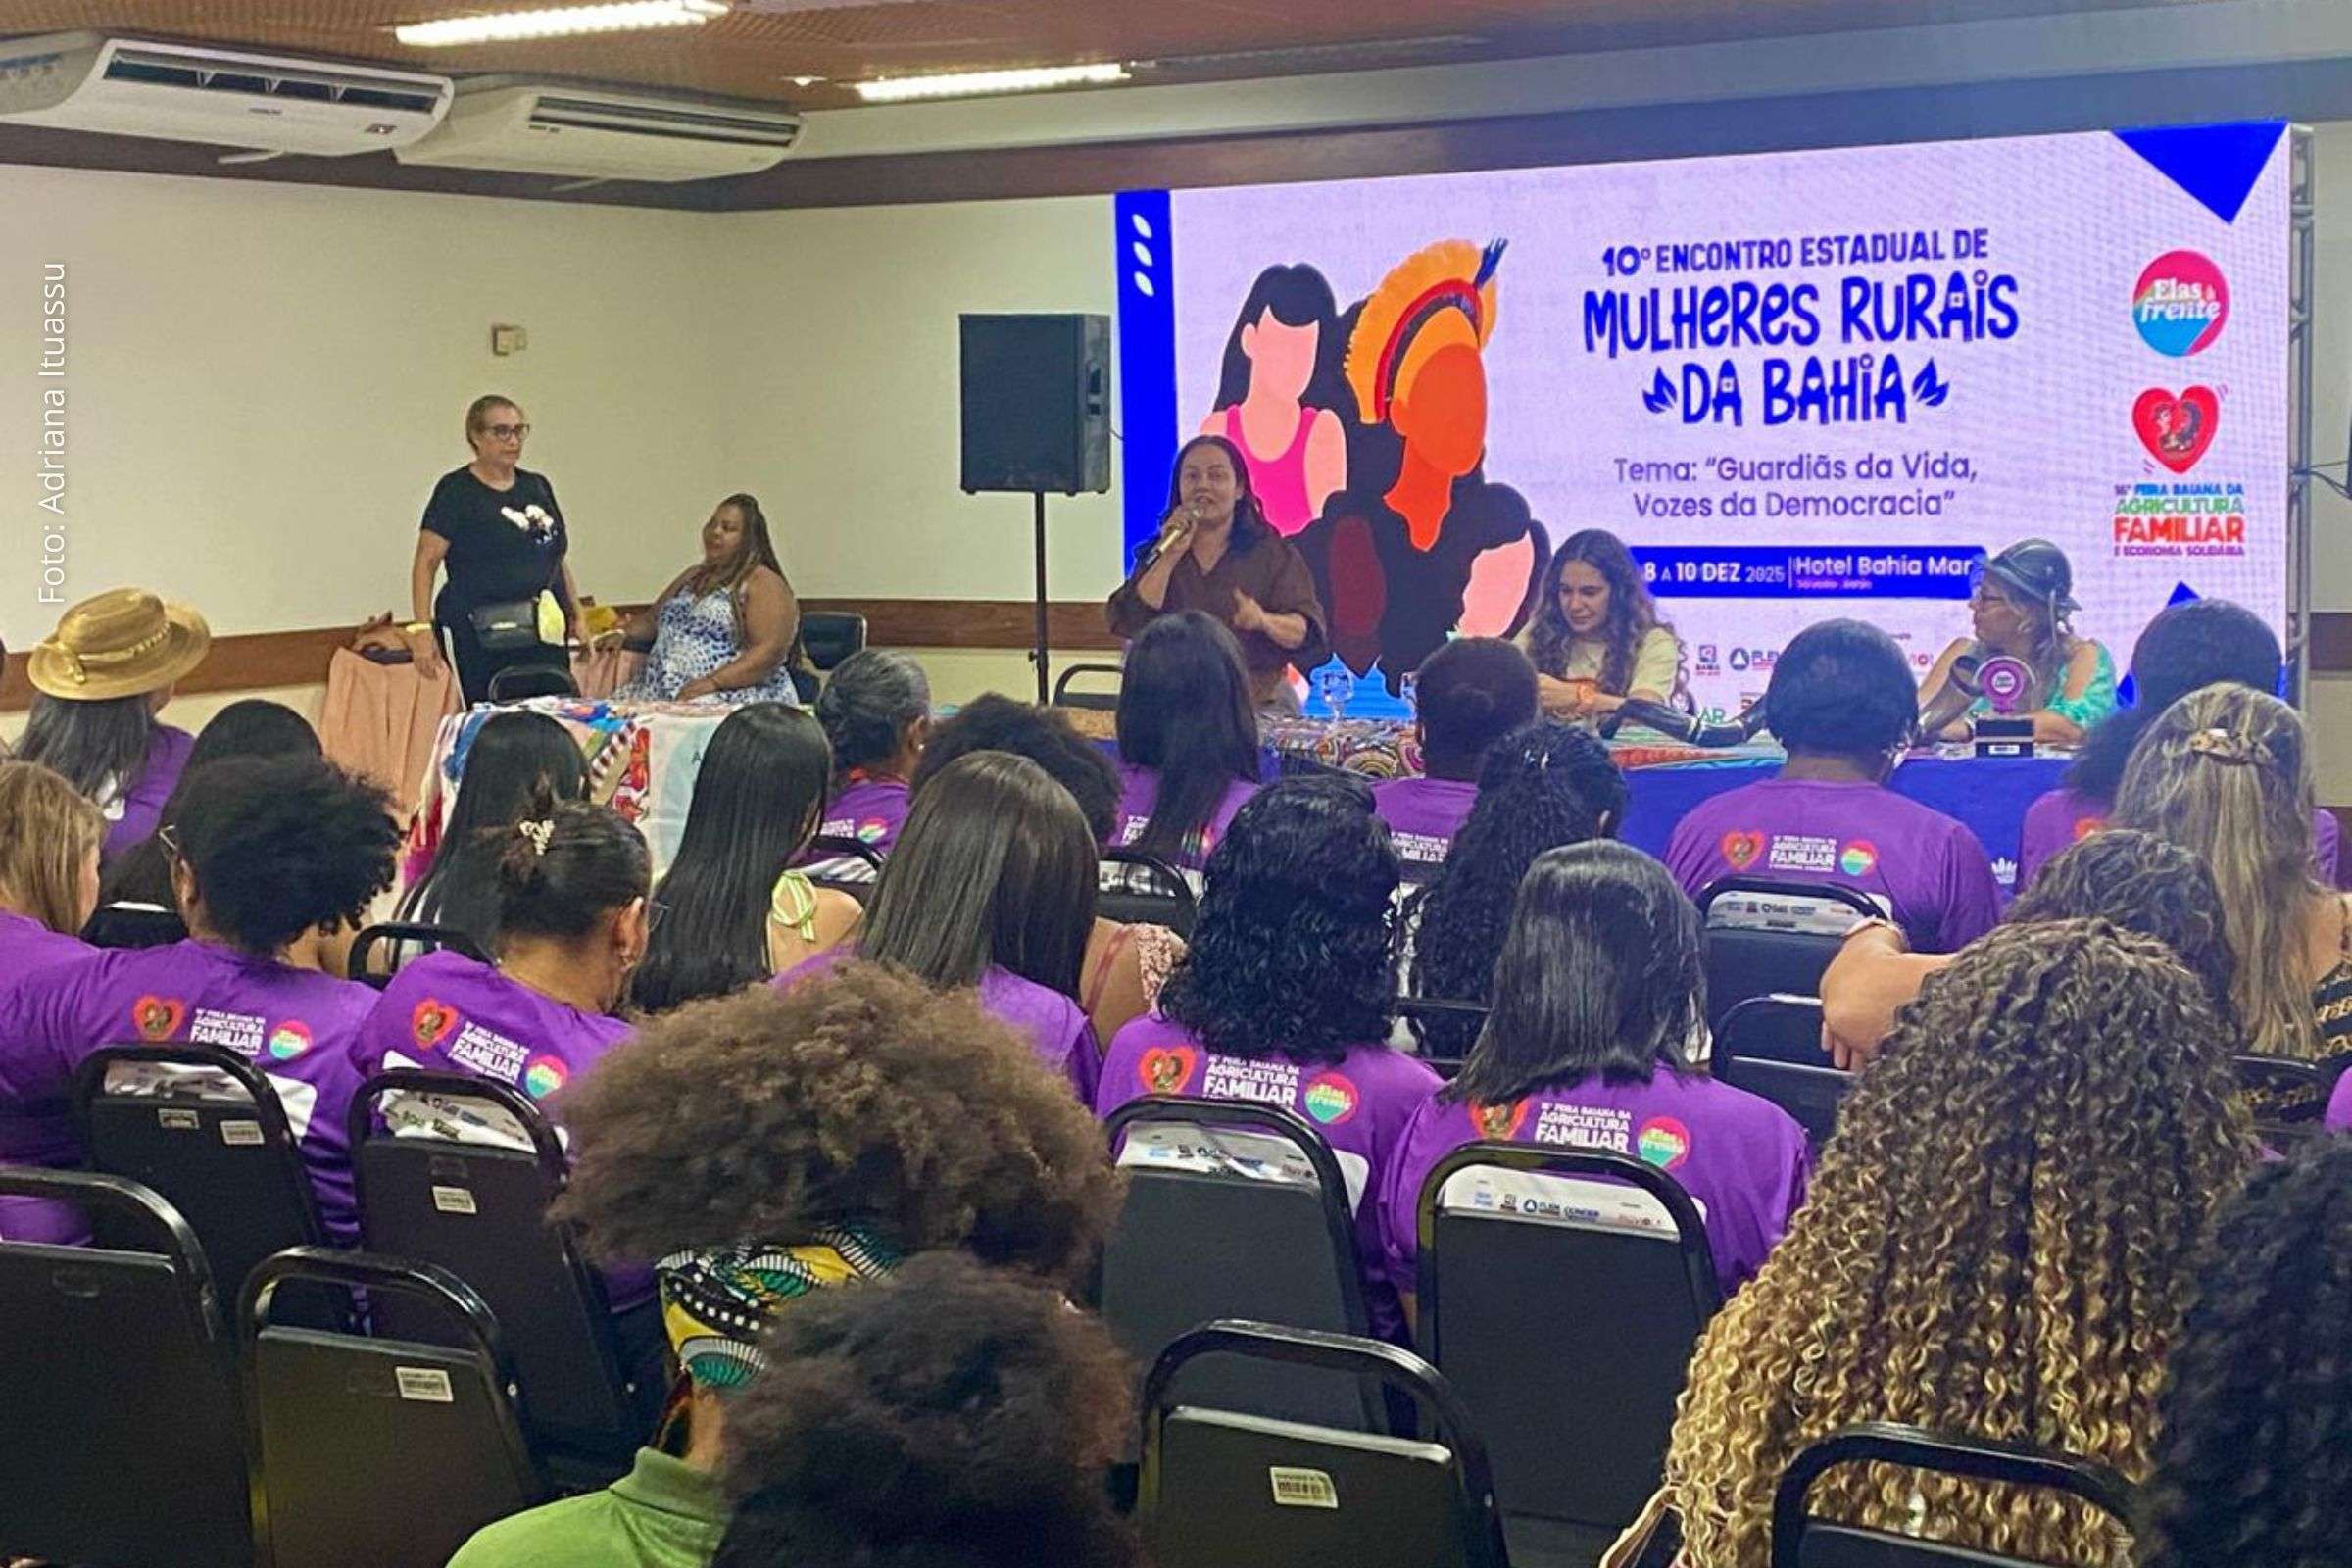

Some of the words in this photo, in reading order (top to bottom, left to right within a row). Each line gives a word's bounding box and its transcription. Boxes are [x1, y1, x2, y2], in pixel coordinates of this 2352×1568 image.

[1656, 238, 1792, 273] ENCONTRO
[1800, 230, 1946, 267] ESTADUAL
[1953, 228, 1989, 260] DE
[1682, 359, 1743, 426] DA
[1614, 456, 1698, 483] Tema:
[1855, 452, 1893, 478] da
[1901, 450, 1979, 483] Vida,
[1634, 492, 1713, 518] Vozes
[1721, 491, 1757, 517] da
[2115, 496, 2245, 514] AGRICULTURA
[2114, 516, 2245, 543] FAMILIAR
[1675, 561, 1697, 582] 10
[1702, 562, 1741, 583] DEZ
[1745, 565, 1786, 583] 2025
[1795, 554, 1852, 576] Hotel
[1858, 553, 1923, 576] Bahia
[1928, 555, 1972, 576] Mar
[1206, 1063, 1298, 1088] AGRICULTURA
[1202, 1075, 1297, 1106] FAMILIAR
[1538, 1110, 1630, 1133] AGRICULTURA
[1534, 1122, 1630, 1153] FAMILIAR
